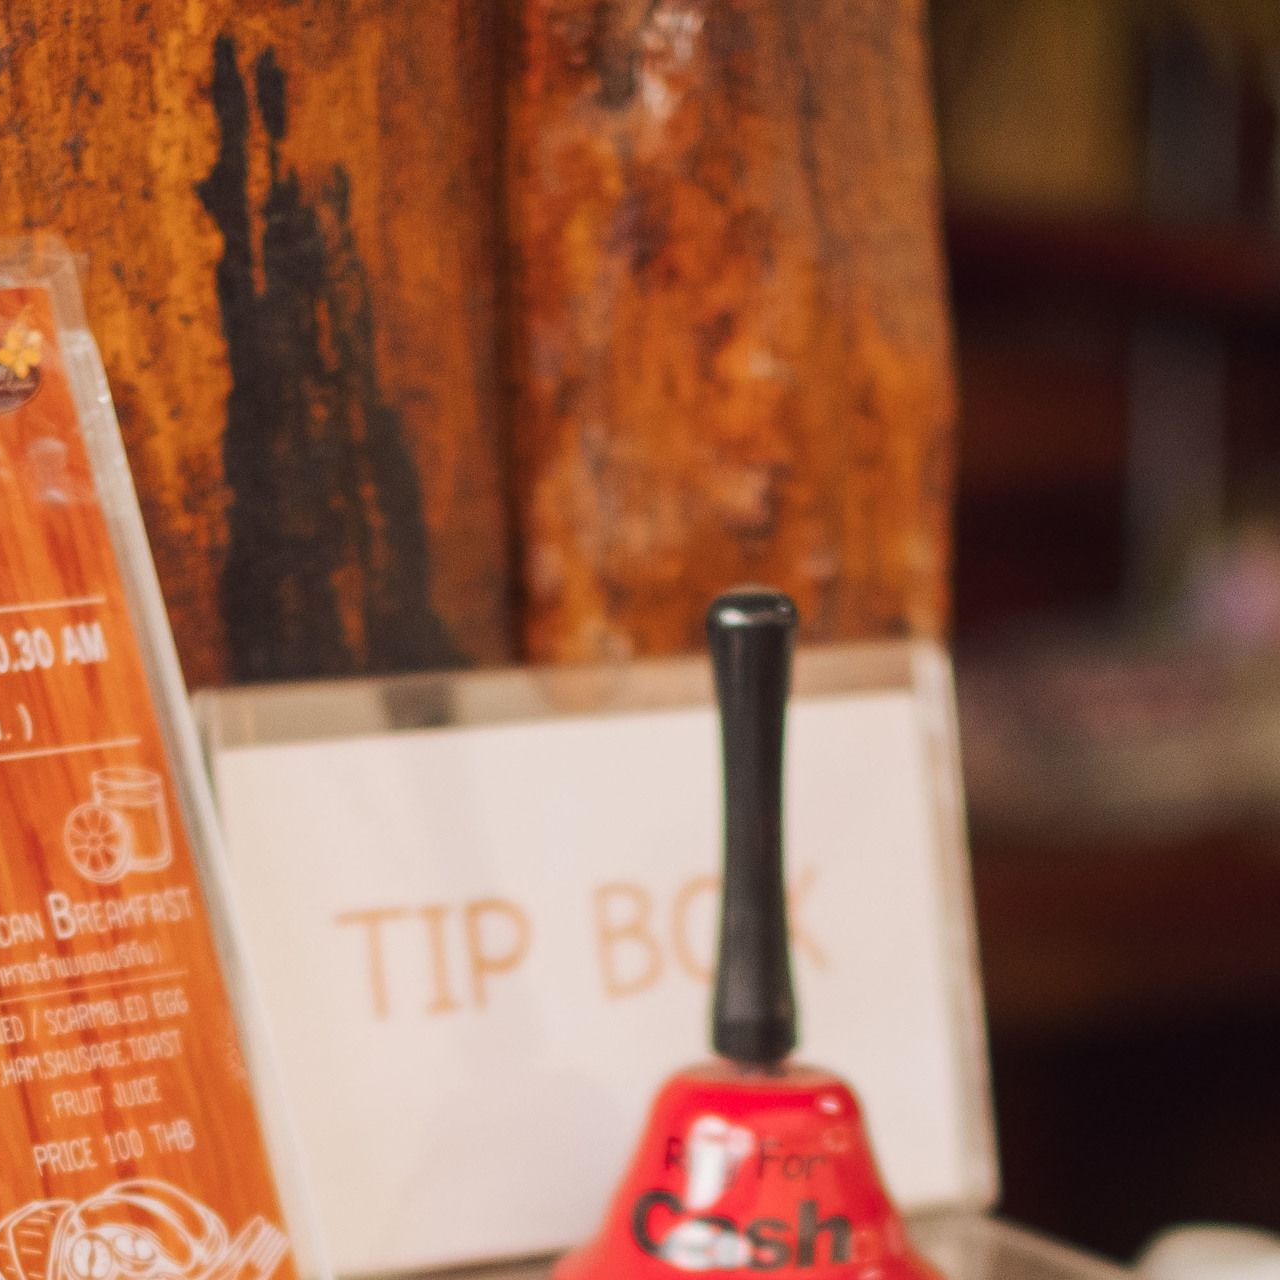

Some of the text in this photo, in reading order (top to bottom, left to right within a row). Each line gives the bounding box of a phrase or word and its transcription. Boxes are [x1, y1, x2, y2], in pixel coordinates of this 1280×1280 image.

[61, 621, 108, 665] AM
[332, 894, 535, 1023] TIP
[152, 988, 190, 1019] EGG
[51, 1085, 104, 1119] FRUIT
[113, 1075, 163, 1109] JUICE
[33, 1118, 196, 1177] PRICE 100 THB
[757, 1139, 827, 1180] For
